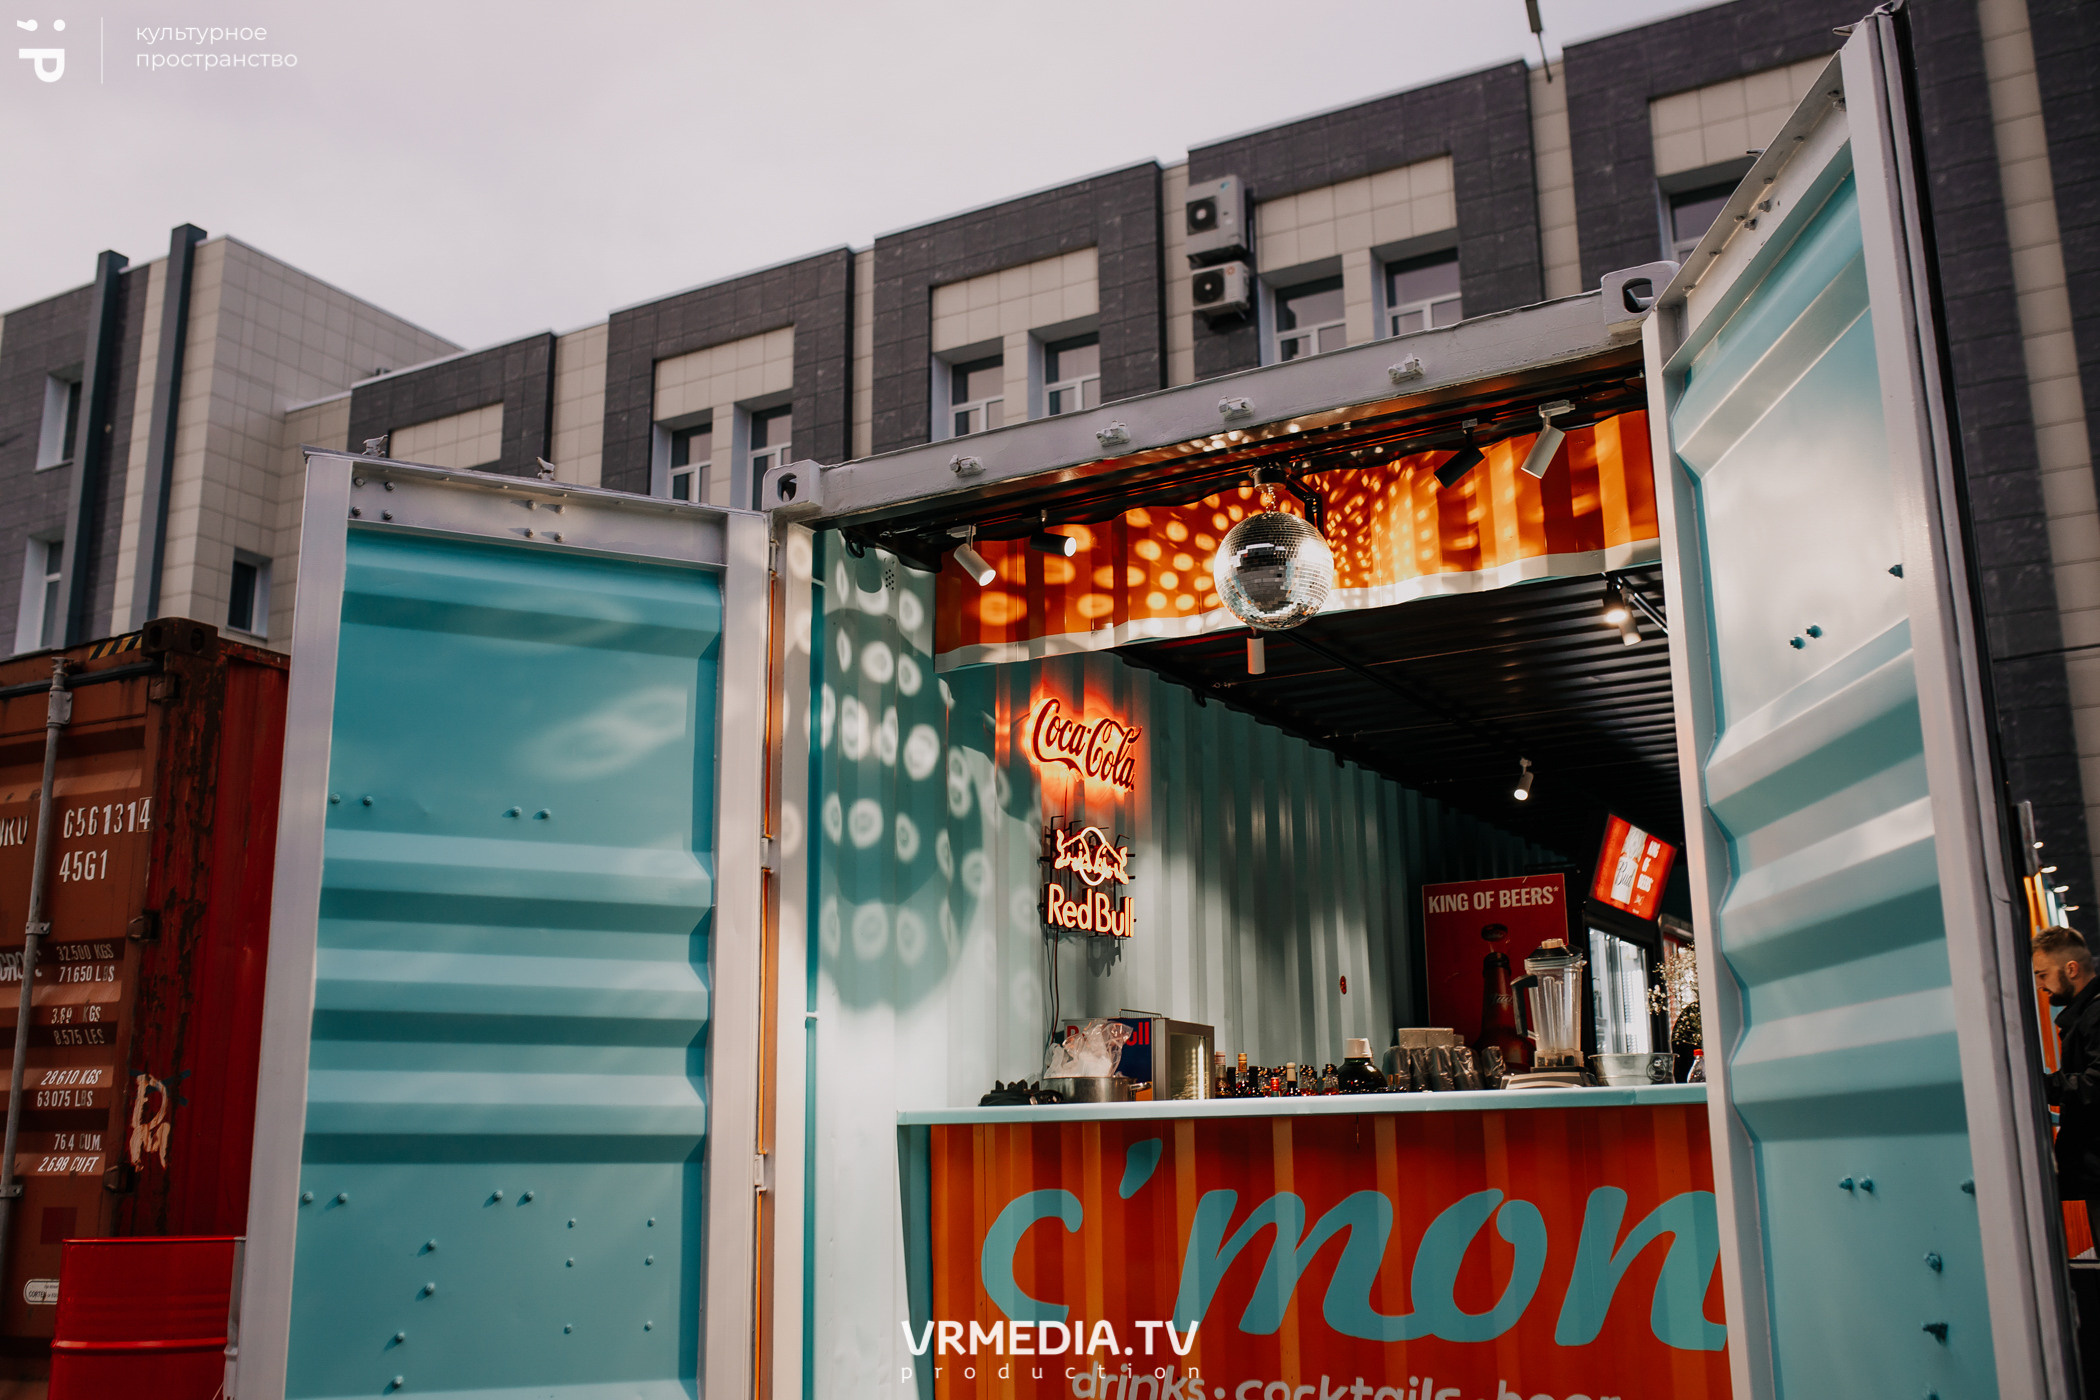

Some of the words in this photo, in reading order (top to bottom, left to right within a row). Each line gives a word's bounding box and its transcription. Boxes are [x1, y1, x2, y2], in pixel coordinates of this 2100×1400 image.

[1033, 698, 1142, 790] Coca-Cola
[59, 849, 108, 882] 45G1
[1428, 893, 1469, 914] KING
[1473, 891, 1495, 911] OF
[93, 943, 114, 959] KGS
[95, 965, 115, 982] LBS
[1126, 1021, 1150, 1046] ull
[78, 1068, 103, 1085] KGS
[75, 1090, 93, 1107] LBS
[981, 1137, 1728, 1351] c'mon
[1072, 1360, 1206, 1400] drinks
